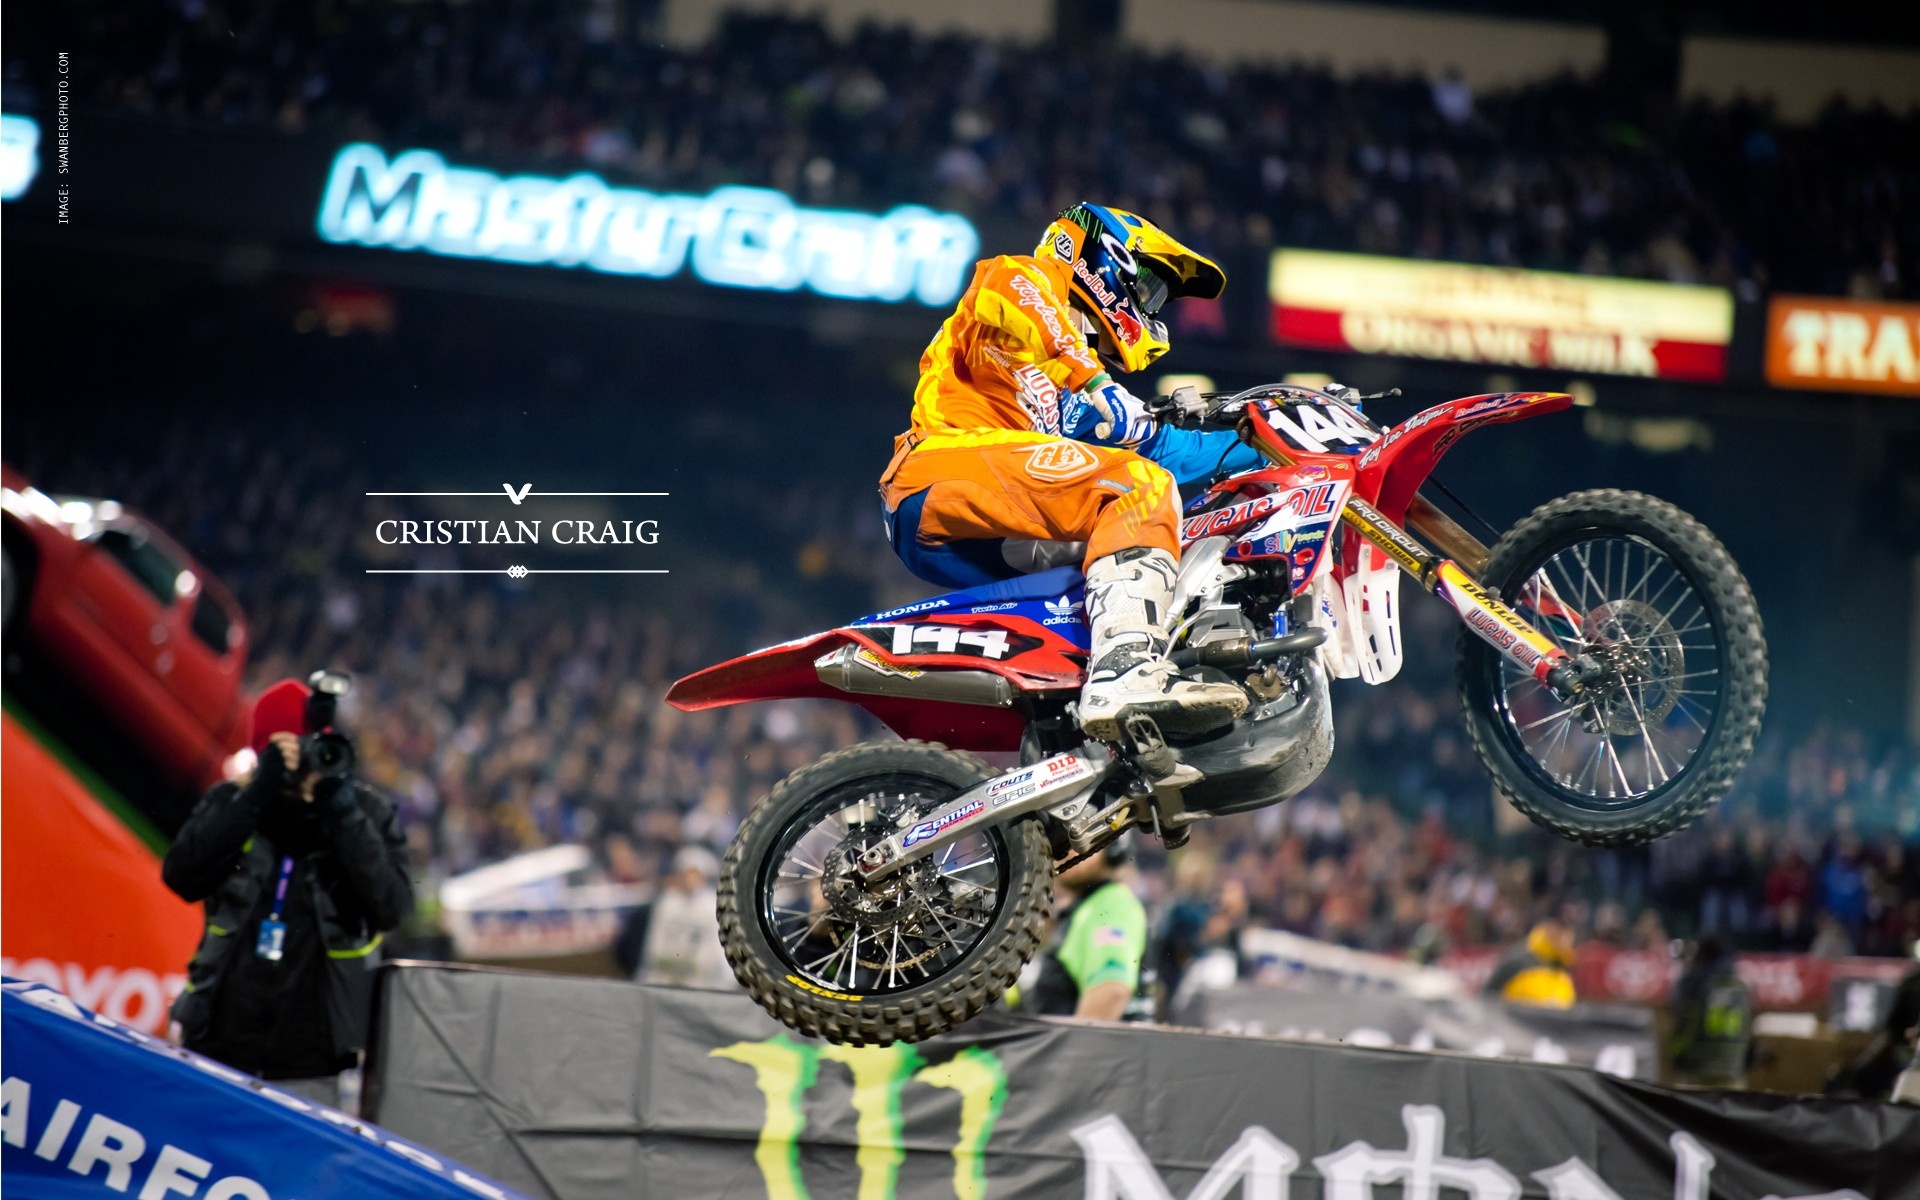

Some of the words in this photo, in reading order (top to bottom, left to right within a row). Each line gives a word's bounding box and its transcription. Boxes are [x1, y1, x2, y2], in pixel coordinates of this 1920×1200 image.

[1548, 328, 1660, 377] MILK
[1782, 309, 1920, 383] TRA
[1020, 364, 1060, 429] LUCAS
[1268, 404, 1380, 453] 144
[1382, 430, 1402, 449] Lee
[1288, 484, 1336, 517] OIL
[1367, 529, 1414, 566] SHOWA
[876, 599, 950, 621] HONDA
[971, 605, 998, 614] Twin
[999, 602, 1018, 611] Air
[1043, 611, 1082, 626] adidas
[1460, 582, 1534, 634] DUNLOP
[892, 625, 1010, 659] 144
[1465, 607, 1515, 649] LUCAS
[1512, 643, 1542, 669] OIL
[0, 957, 188, 1036] OYO
